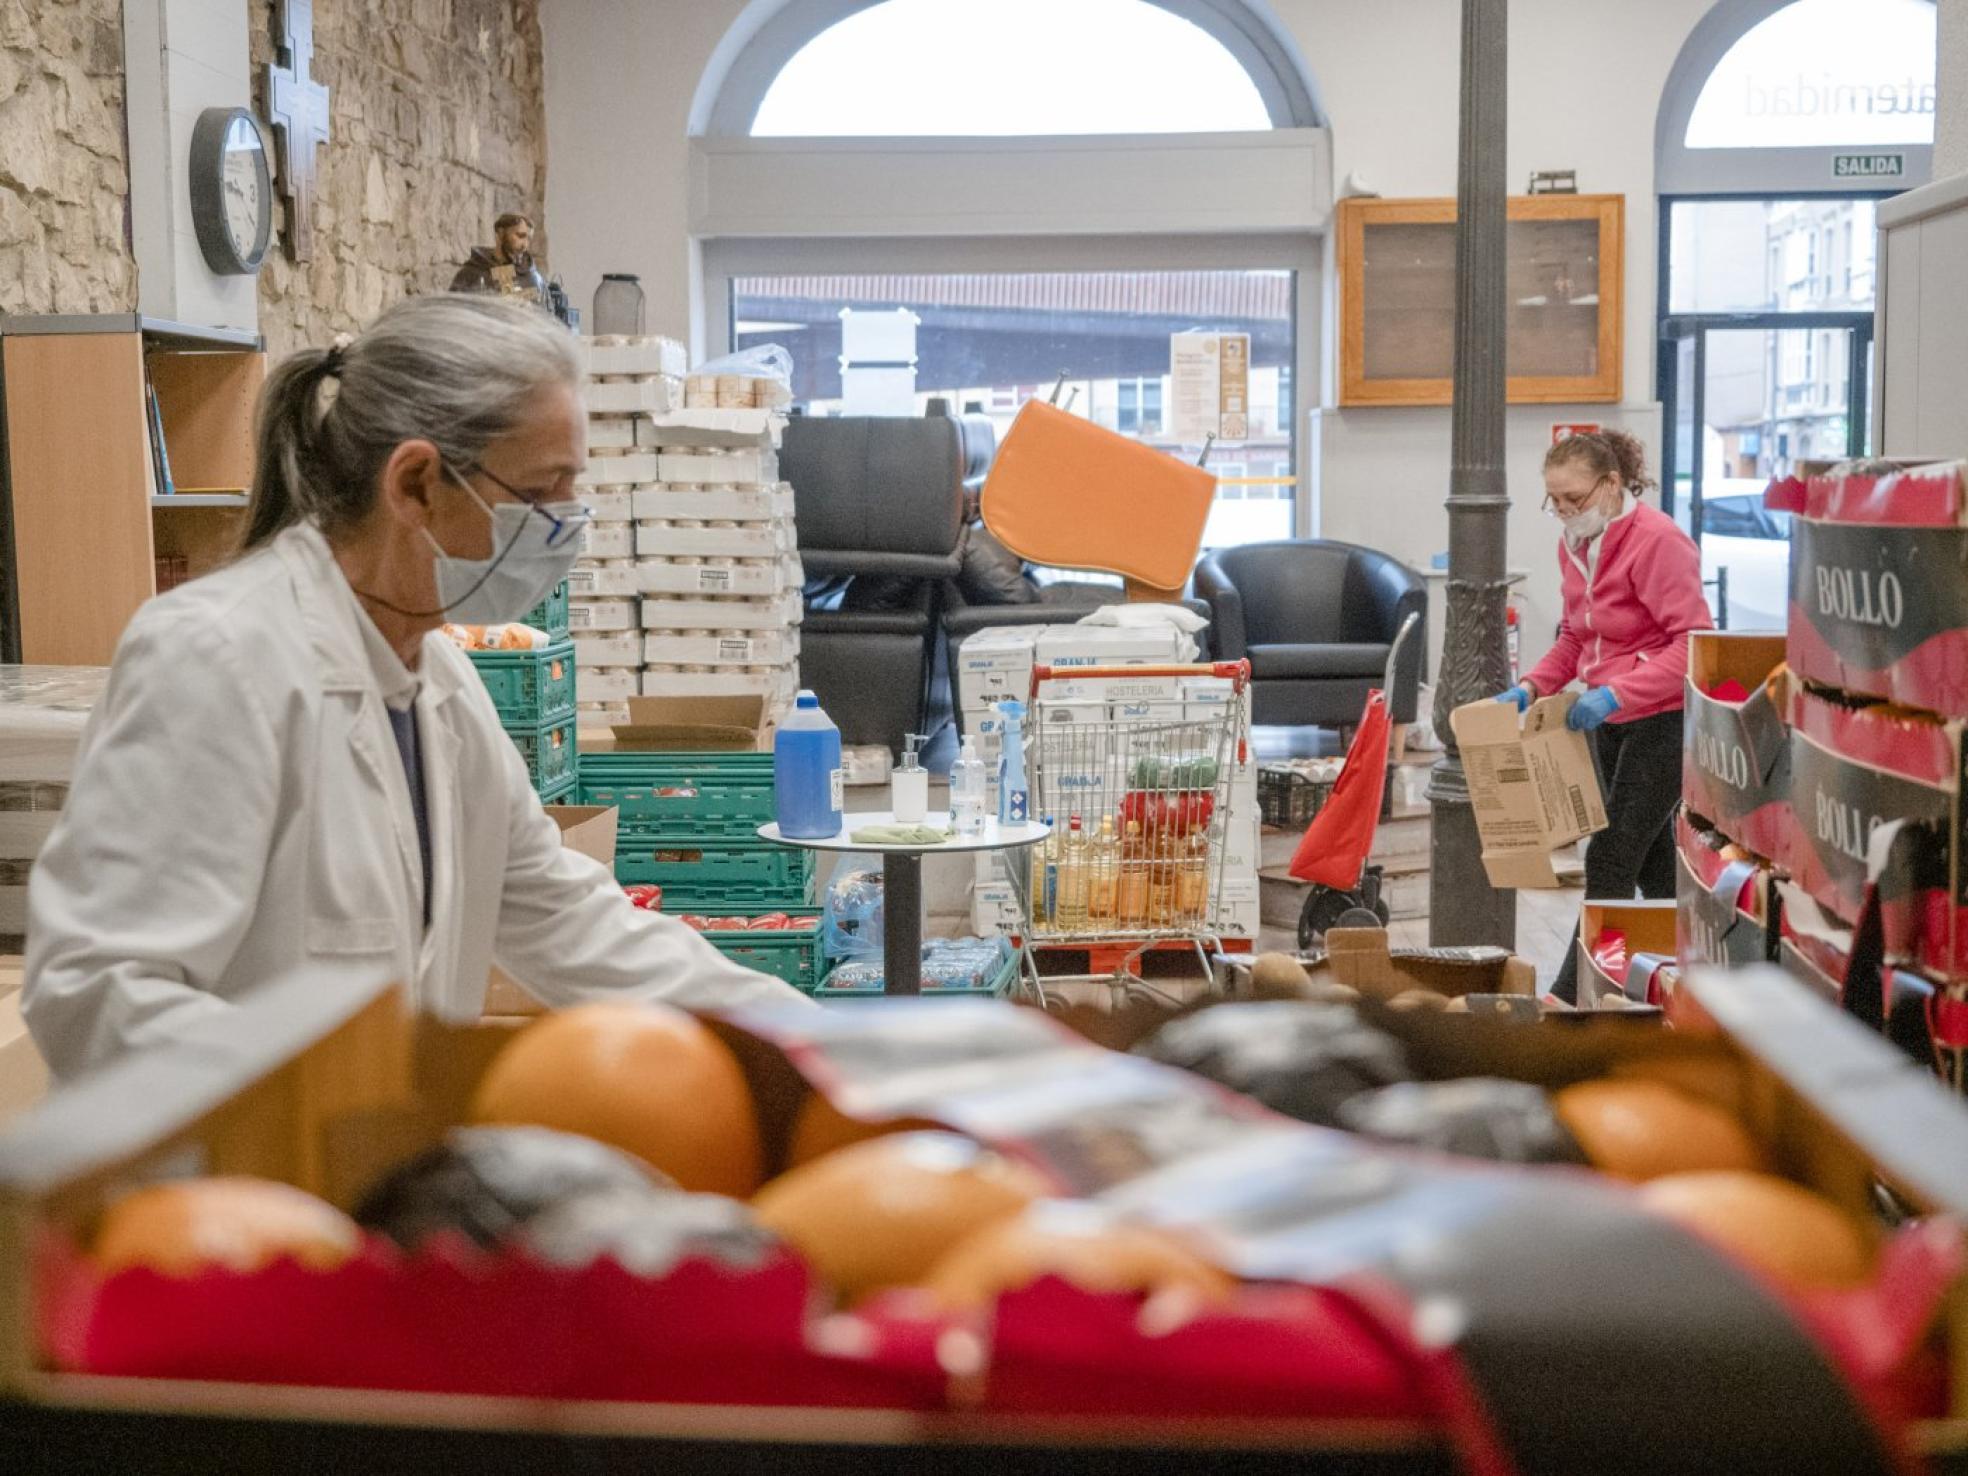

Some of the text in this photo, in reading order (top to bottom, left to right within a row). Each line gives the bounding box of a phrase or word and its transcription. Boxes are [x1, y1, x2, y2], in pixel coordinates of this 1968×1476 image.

[1836, 155, 1899, 175] SALIDA
[1816, 565, 1903, 628] BOLLO
[1105, 685, 1164, 697] HOSTELERIA
[1697, 733, 1748, 790] BOLLO
[1815, 788, 1885, 863] BOLL
